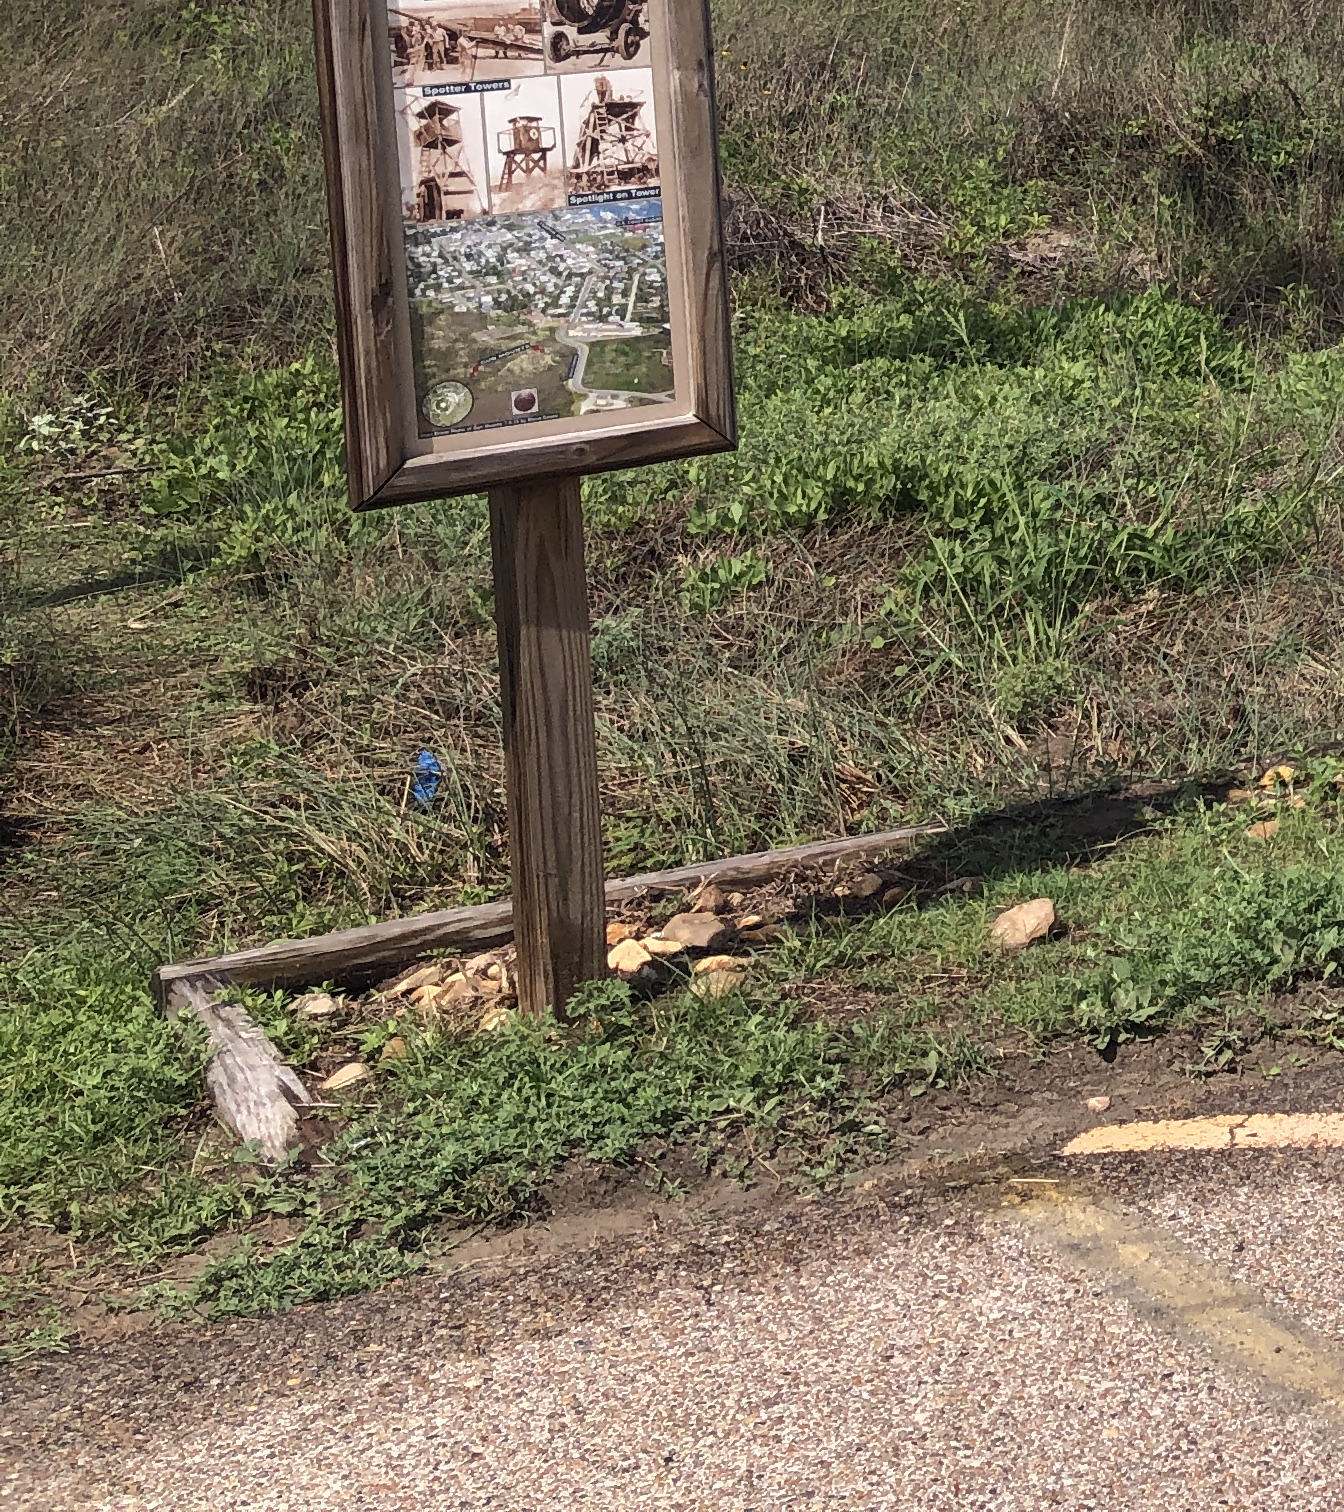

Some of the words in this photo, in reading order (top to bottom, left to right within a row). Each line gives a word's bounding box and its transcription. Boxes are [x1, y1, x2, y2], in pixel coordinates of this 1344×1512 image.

[424, 86, 466, 96] Spotter
[469, 82, 509, 90] Towers
[570, 193, 613, 204] Spotlight
[631, 188, 659, 197] Tower
